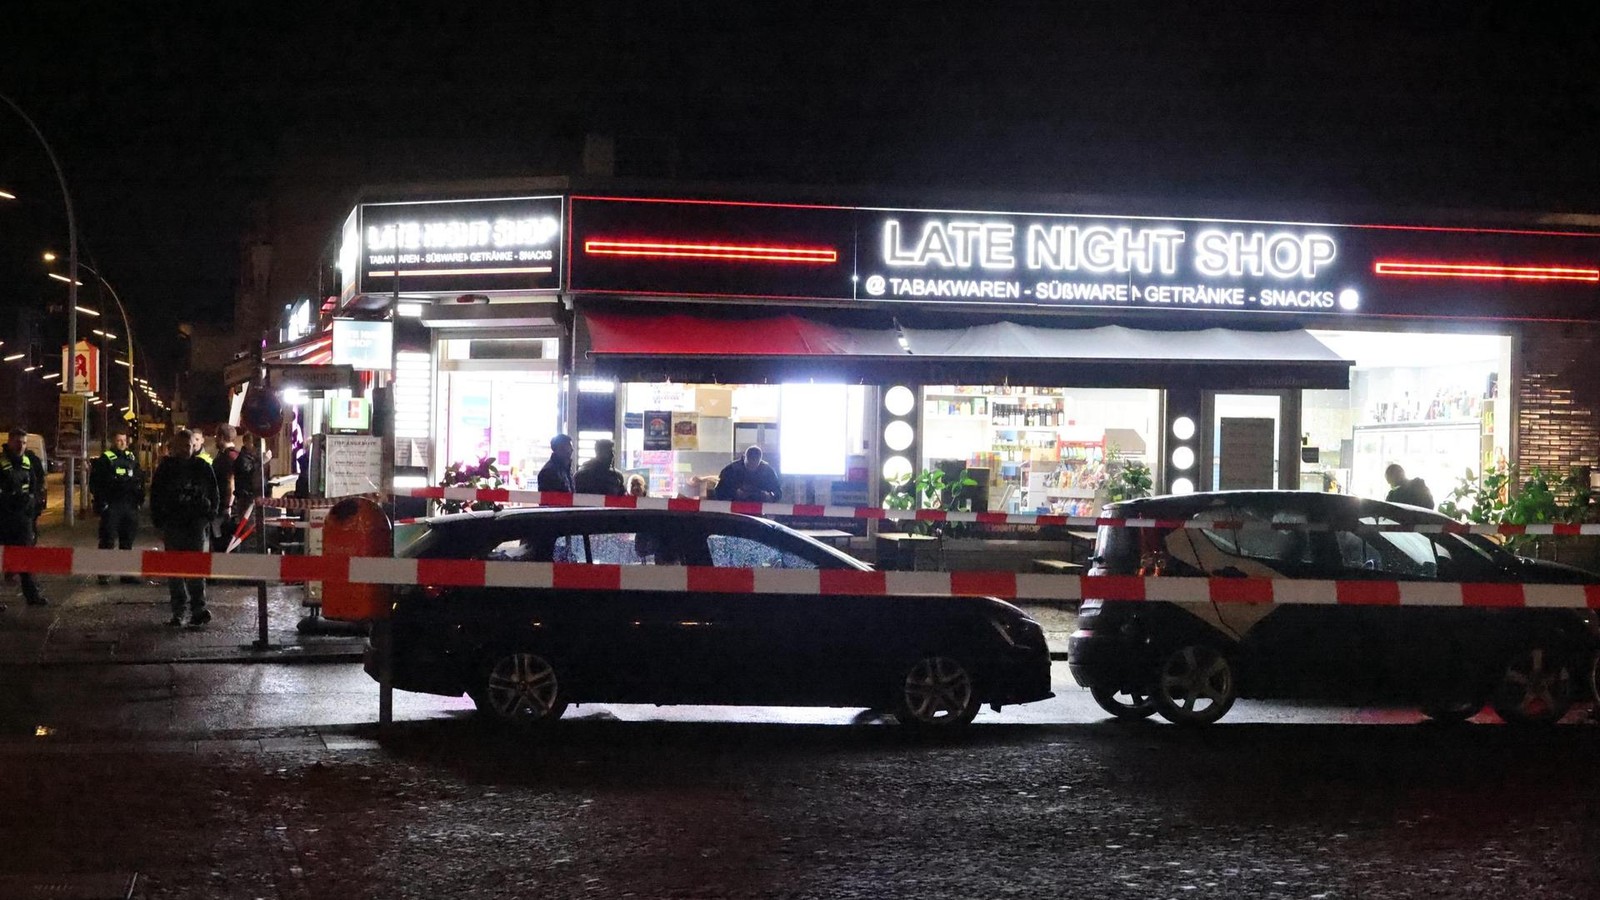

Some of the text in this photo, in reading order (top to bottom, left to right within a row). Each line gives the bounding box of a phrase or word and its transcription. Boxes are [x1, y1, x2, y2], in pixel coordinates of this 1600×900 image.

[494, 217, 557, 246] SHOP
[519, 250, 552, 260] SNACKS
[884, 220, 1337, 279] LATE NIGHT SHOP
[890, 278, 1020, 298] TABAKWAREN
[1144, 283, 1244, 305] GETRÄNKE
[1260, 290, 1335, 308] SNACKS
